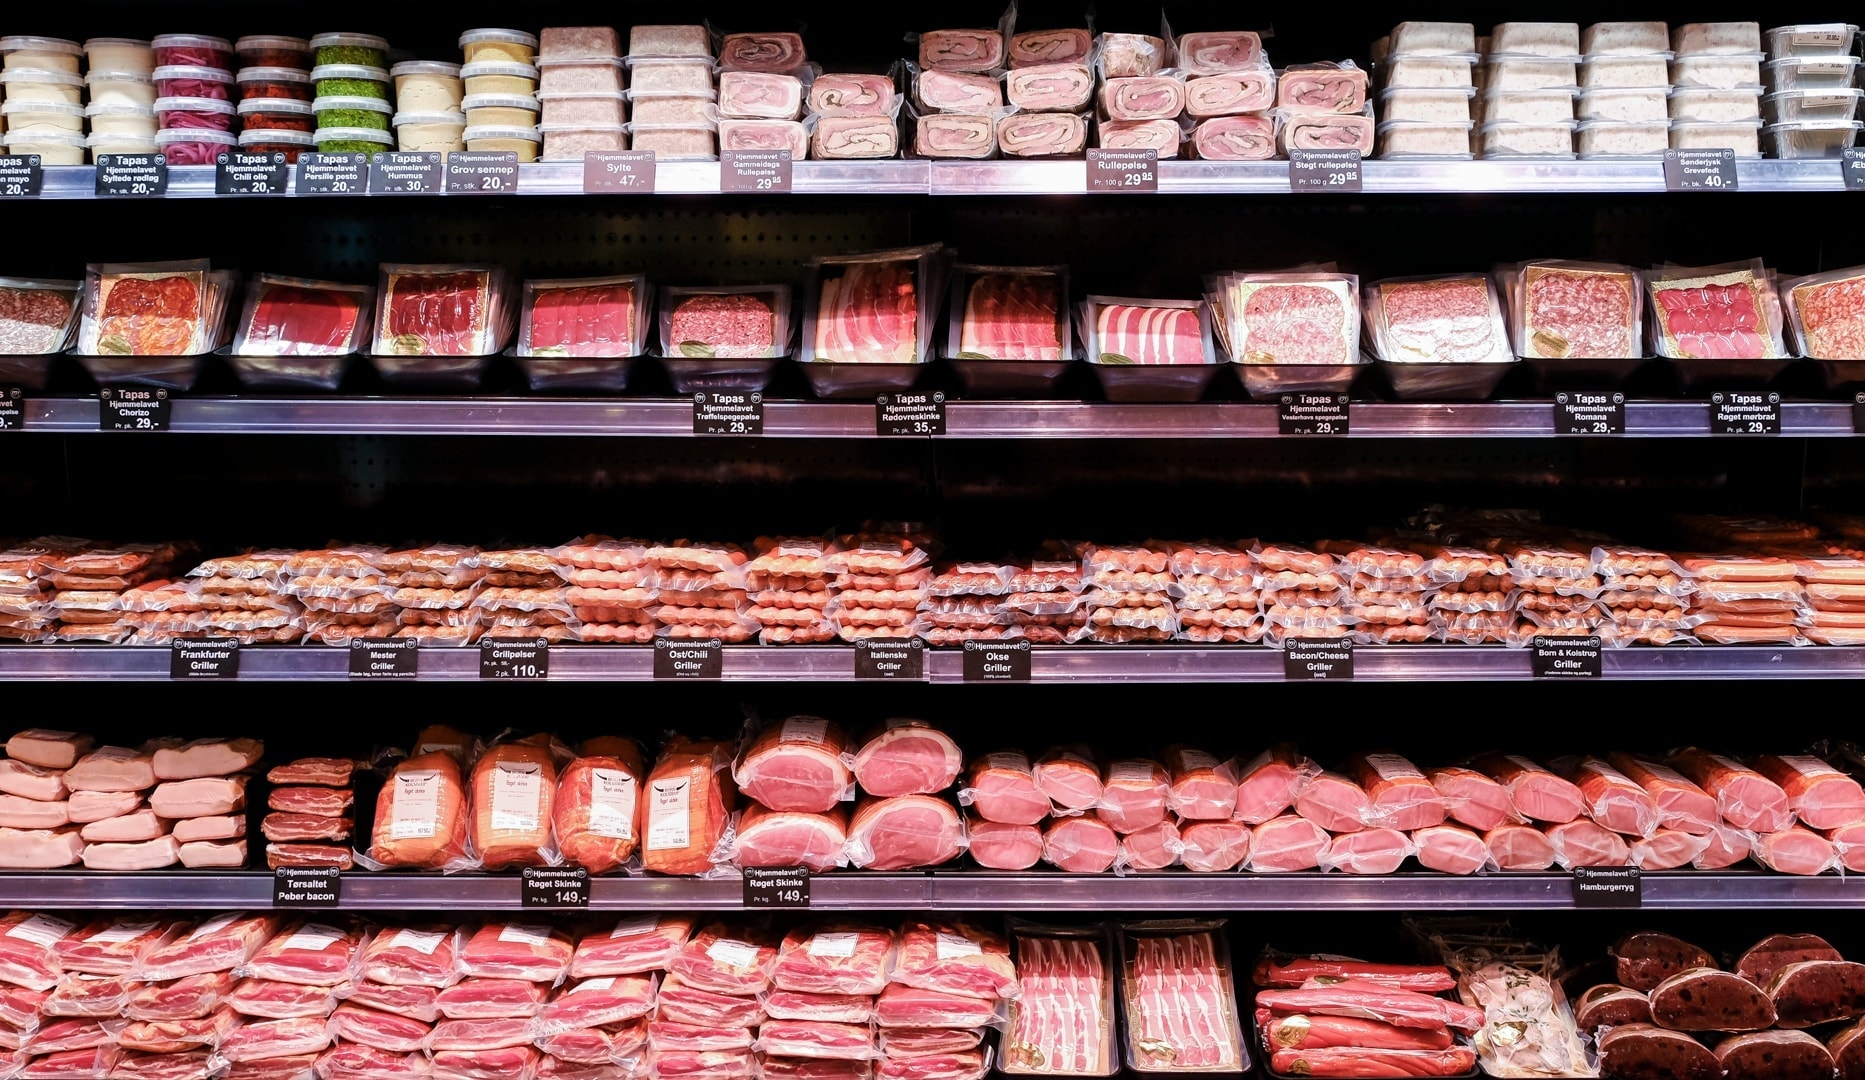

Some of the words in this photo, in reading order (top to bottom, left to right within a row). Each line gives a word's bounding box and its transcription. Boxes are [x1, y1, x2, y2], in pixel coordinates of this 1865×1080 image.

[235, 154, 268, 165] Tapas
[316, 155, 349, 165] Tapas
[390, 154, 422, 164] Tapas
[460, 155, 505, 163] Hjemmelavet
[1100, 152, 1145, 160] Hjemmelavet
[1303, 152, 1349, 160] Hjemmelavet
[116, 156, 148, 167] Tapas
[1296, 162, 1317, 170] Stegt
[1318, 162, 1357, 170] rullepølse
[106, 167, 156, 175] Hjemmelavet
[226, 165, 276, 173] Hjemmelavet
[307, 165, 357, 173] Hjemmelavet
[381, 165, 431, 173] Hjemmelavet
[451, 166, 474, 174] Grov
[477, 166, 514, 176] sennep
[607, 163, 632, 173] Sylte
[1098, 162, 1147, 171] Rullepølse
[103, 175, 132, 183] Syltede
[1705, 175, 1731, 188] 40,-
[252, 182, 275, 193] 20,-
[332, 182, 356, 193] 20,-
[407, 181, 429, 192] 30,-
[482, 177, 511, 191] 20,-
[6, 185, 29, 196] 20,-
[131, 183, 155, 195] 20,-
[118, 390, 150, 400] Tapas
[712, 394, 744, 404] Tapas
[895, 394, 926, 405] Tapas
[1300, 394, 1331, 405] Tapas
[1574, 394, 1606, 405] Tapas
[1730, 394, 1762, 405] Tapas
[110, 400, 159, 409] Hjemmelavet
[703, 405, 753, 413] Hjemmelavet
[886, 405, 936, 413] Hjemmelavet
[1566, 405, 1616, 413] Hjemmelavet
[1721, 405, 1771, 413] Hjemmelavet
[1290, 405, 1340, 414] Hjemmelavet
[882, 413, 940, 421] Rødovreskinke
[1718, 413, 1741, 422] Røget
[136, 418, 159, 430] 29,-
[730, 422, 753, 434] 29,-
[914, 422, 936, 434] 35,-
[1316, 423, 1339, 434] 29,-
[1593, 422, 1616, 434] 29,-
[1748, 422, 1771, 434] 29,-
[976, 643, 1020, 651] Hjemmelavet
[1298, 642, 1340, 650] Hjemmelavet
[493, 651, 536, 659] Grillpølser
[670, 650, 708, 658] Ost/Chili
[986, 652, 1009, 661] Okse
[1566, 650, 1597, 658] Kolstrup
[191, 662, 219, 670] Griller
[983, 664, 1012, 672] Griller
[1307, 663, 1333, 671] Griller
[1554, 660, 1582, 668] Griller
[512, 665, 545, 678] 110,-
[287, 869, 329, 877] Hjemmelavet
[287, 880, 327, 888] Tørsaltet
[529, 880, 553, 889] Røget
[554, 880, 581, 888] Skinke
[750, 880, 774, 888] Røget
[1580, 883, 1634, 892] Hamburgerryg
[278, 892, 305, 900] Peber
[307, 892, 334, 900] bacon
[555, 891, 587, 904] 149,-
[777, 890, 809, 902] 149,-
